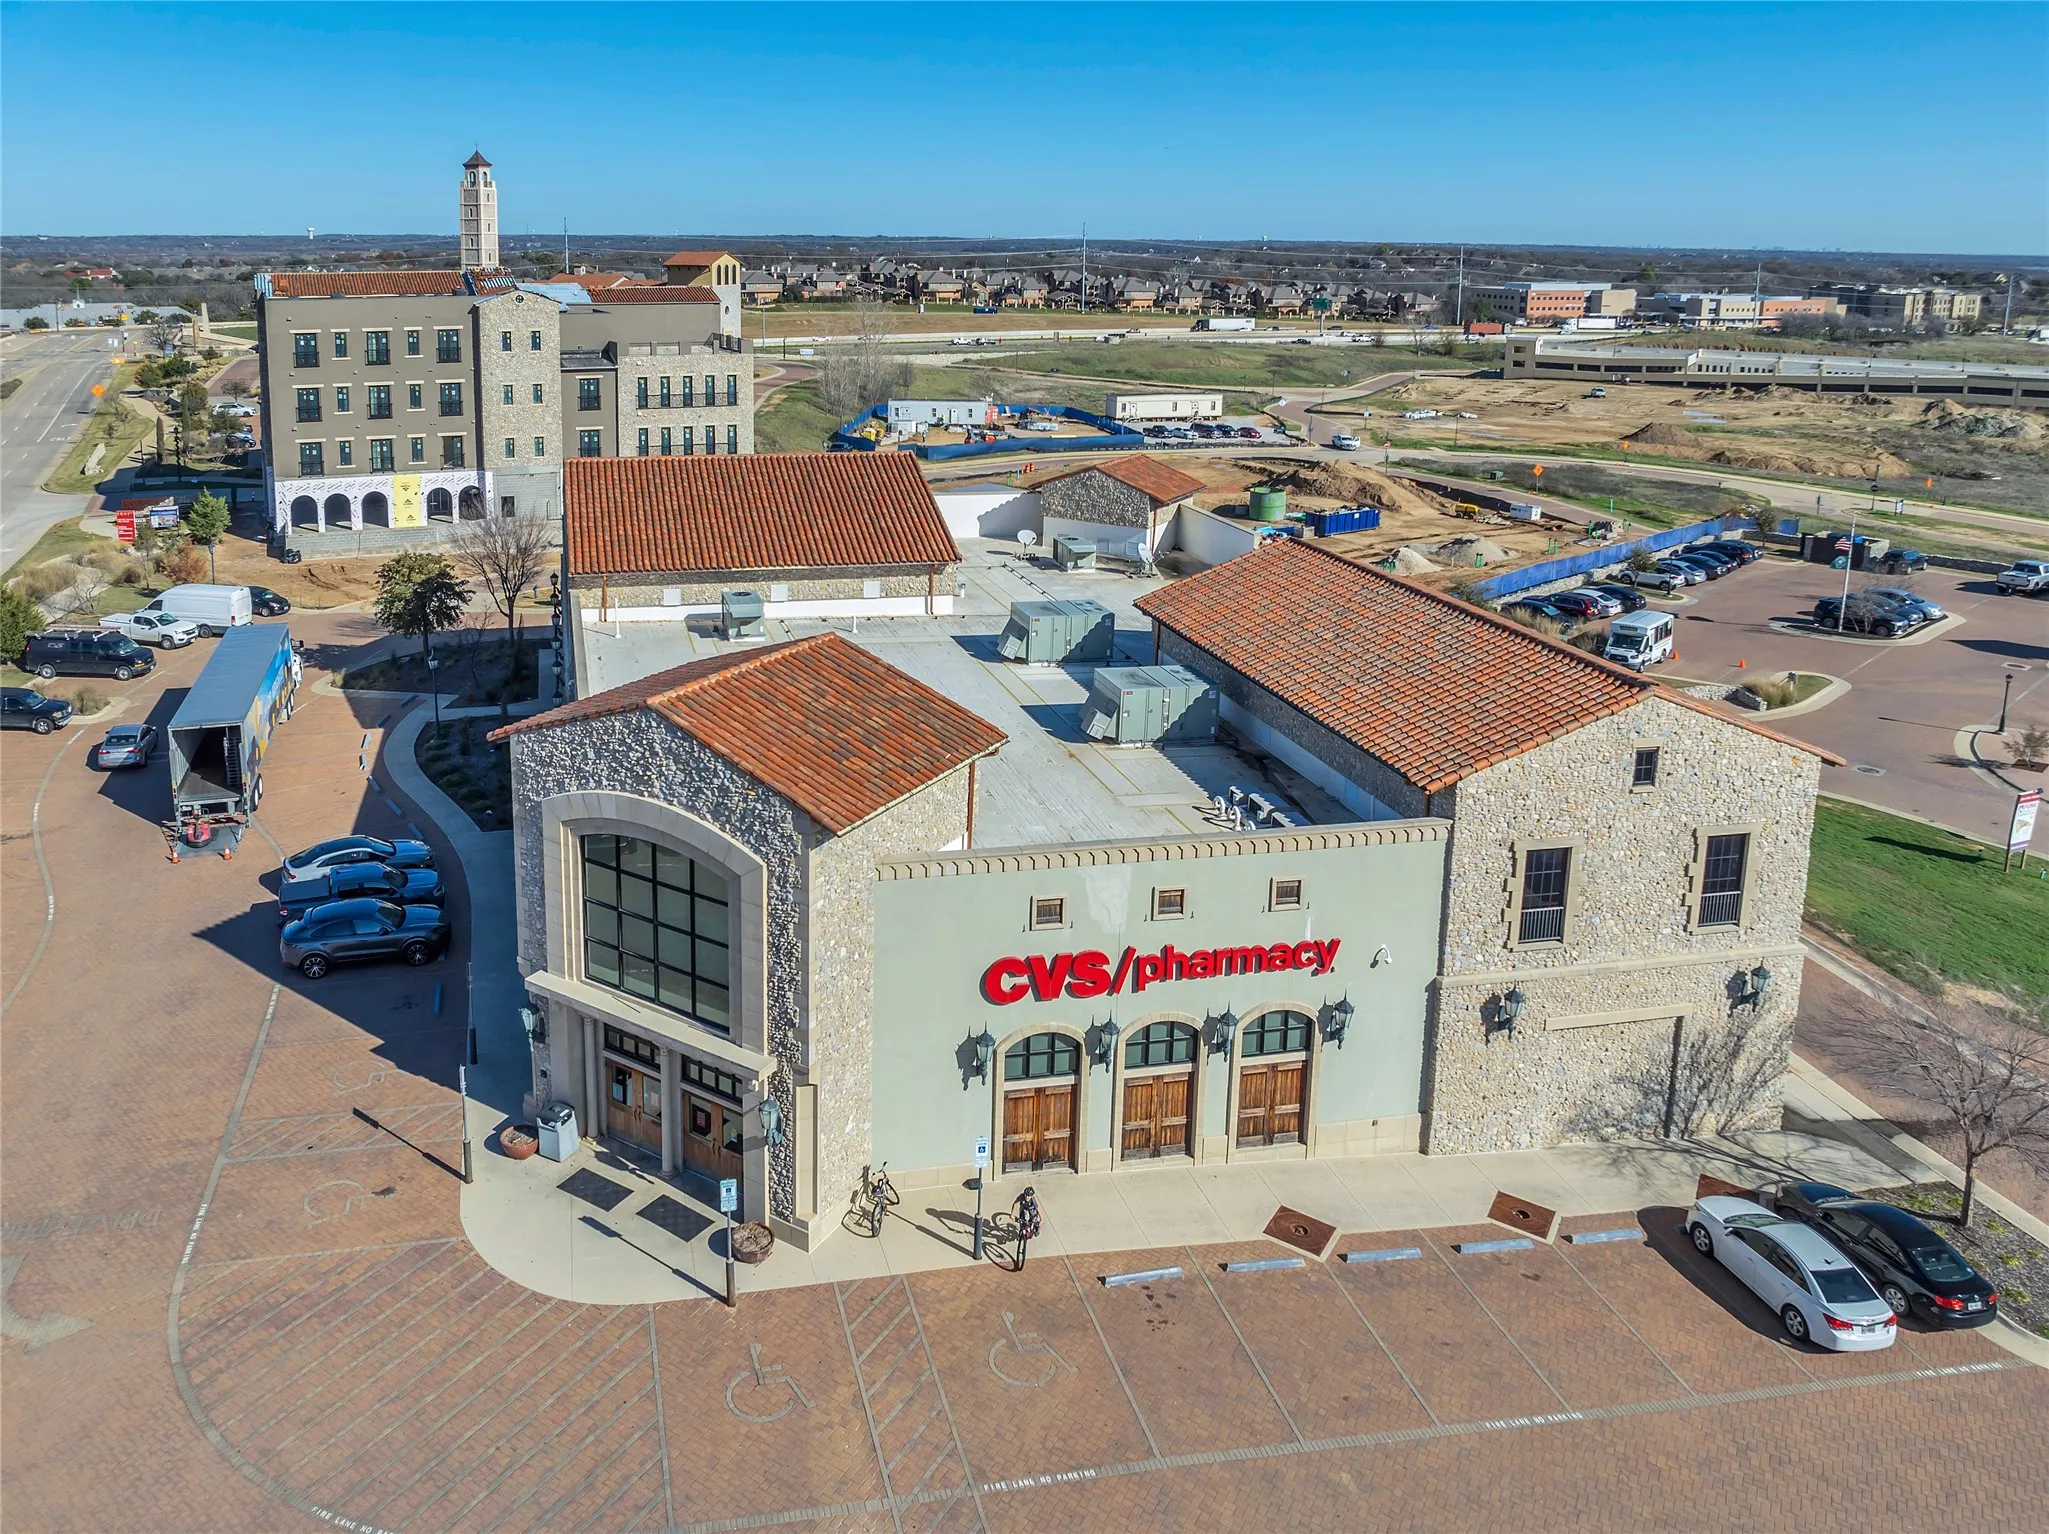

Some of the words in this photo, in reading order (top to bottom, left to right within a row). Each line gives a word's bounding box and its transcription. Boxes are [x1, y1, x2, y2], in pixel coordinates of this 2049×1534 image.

[982, 938, 1342, 1006] CVS/pharmacy
[984, 1481, 1007, 1492] FIRE
[1012, 1477, 1035, 1488] LANE
[1040, 1475, 1052, 1484] NO
[1057, 1469, 1096, 1482] PARKING
[311, 1506, 332, 1520] FIRE
[335, 1517, 357, 1530] LANE
[360, 1525, 373, 1534] NO
